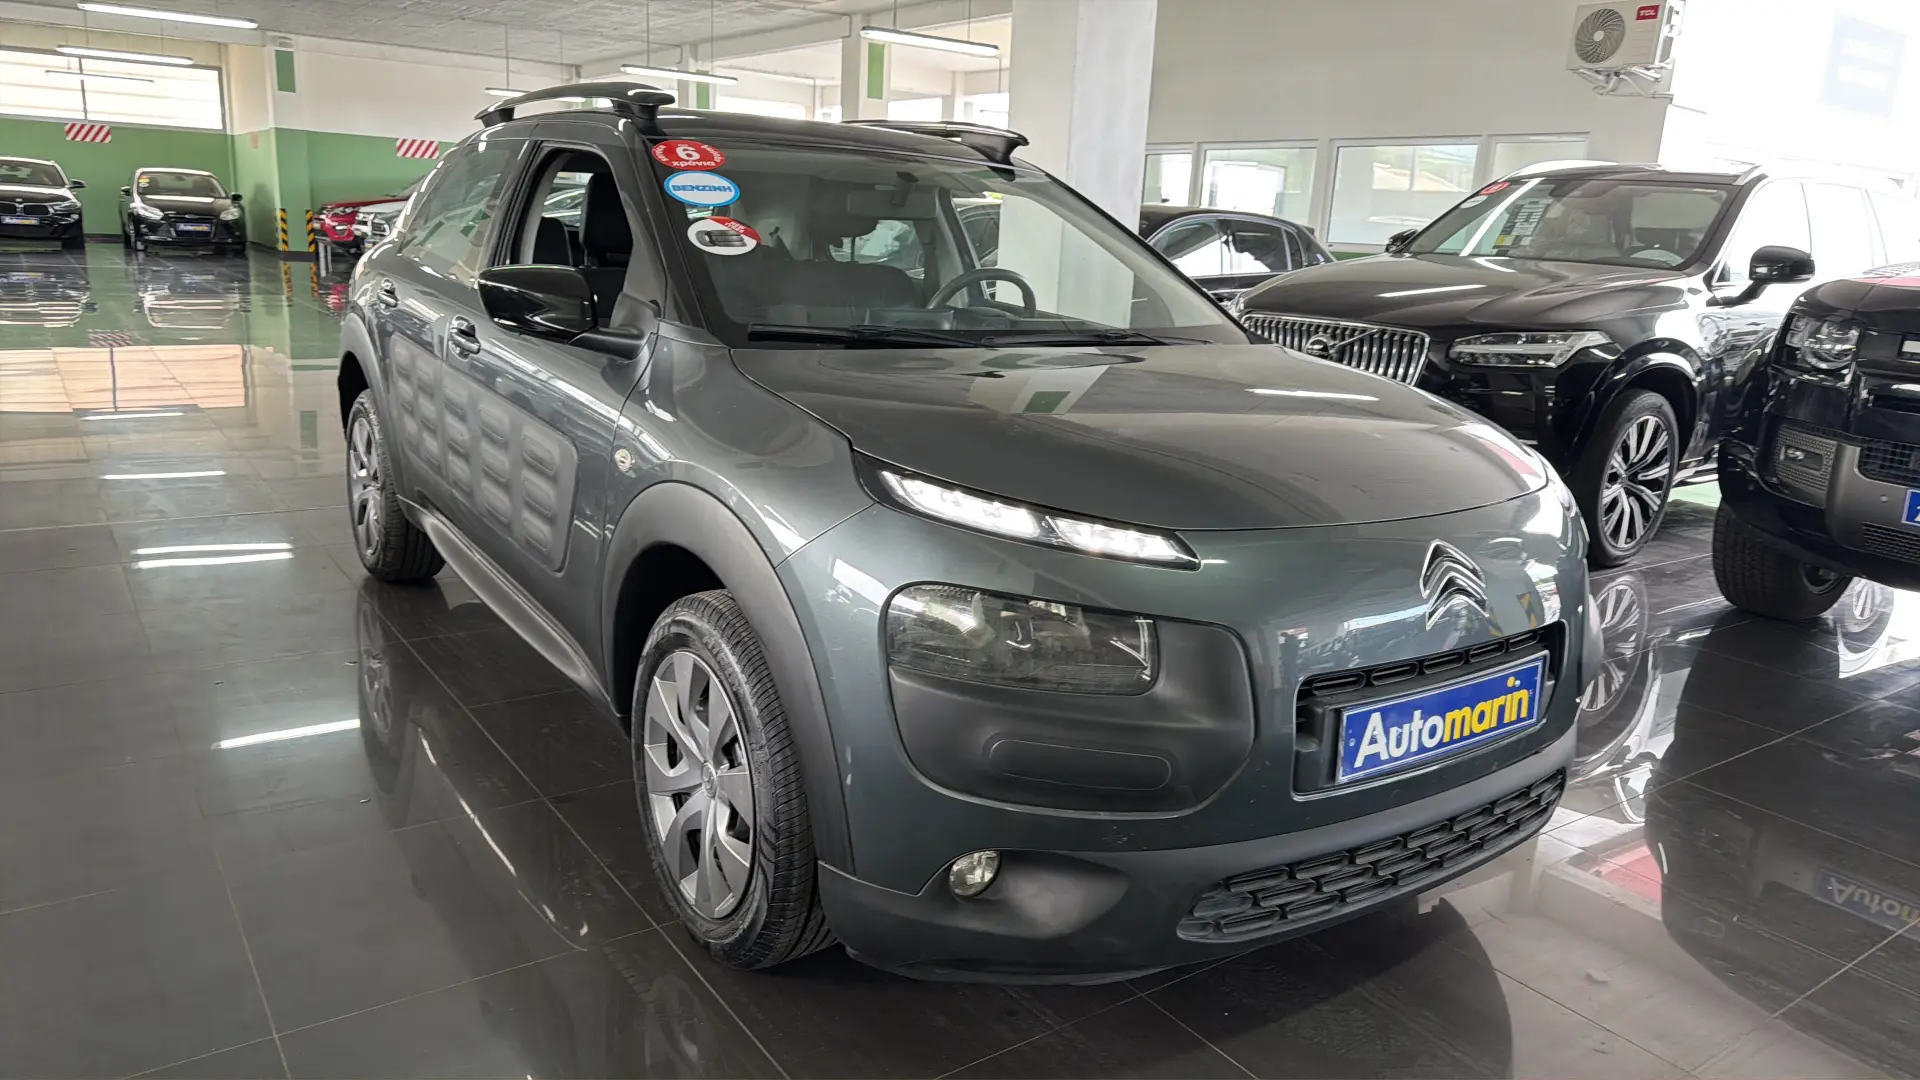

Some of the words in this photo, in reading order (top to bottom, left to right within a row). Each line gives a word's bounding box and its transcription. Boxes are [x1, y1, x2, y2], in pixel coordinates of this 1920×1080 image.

[676, 146, 700, 160] 6
[671, 160, 717, 168] χρόνια
[1353, 676, 1529, 769] Automarin
